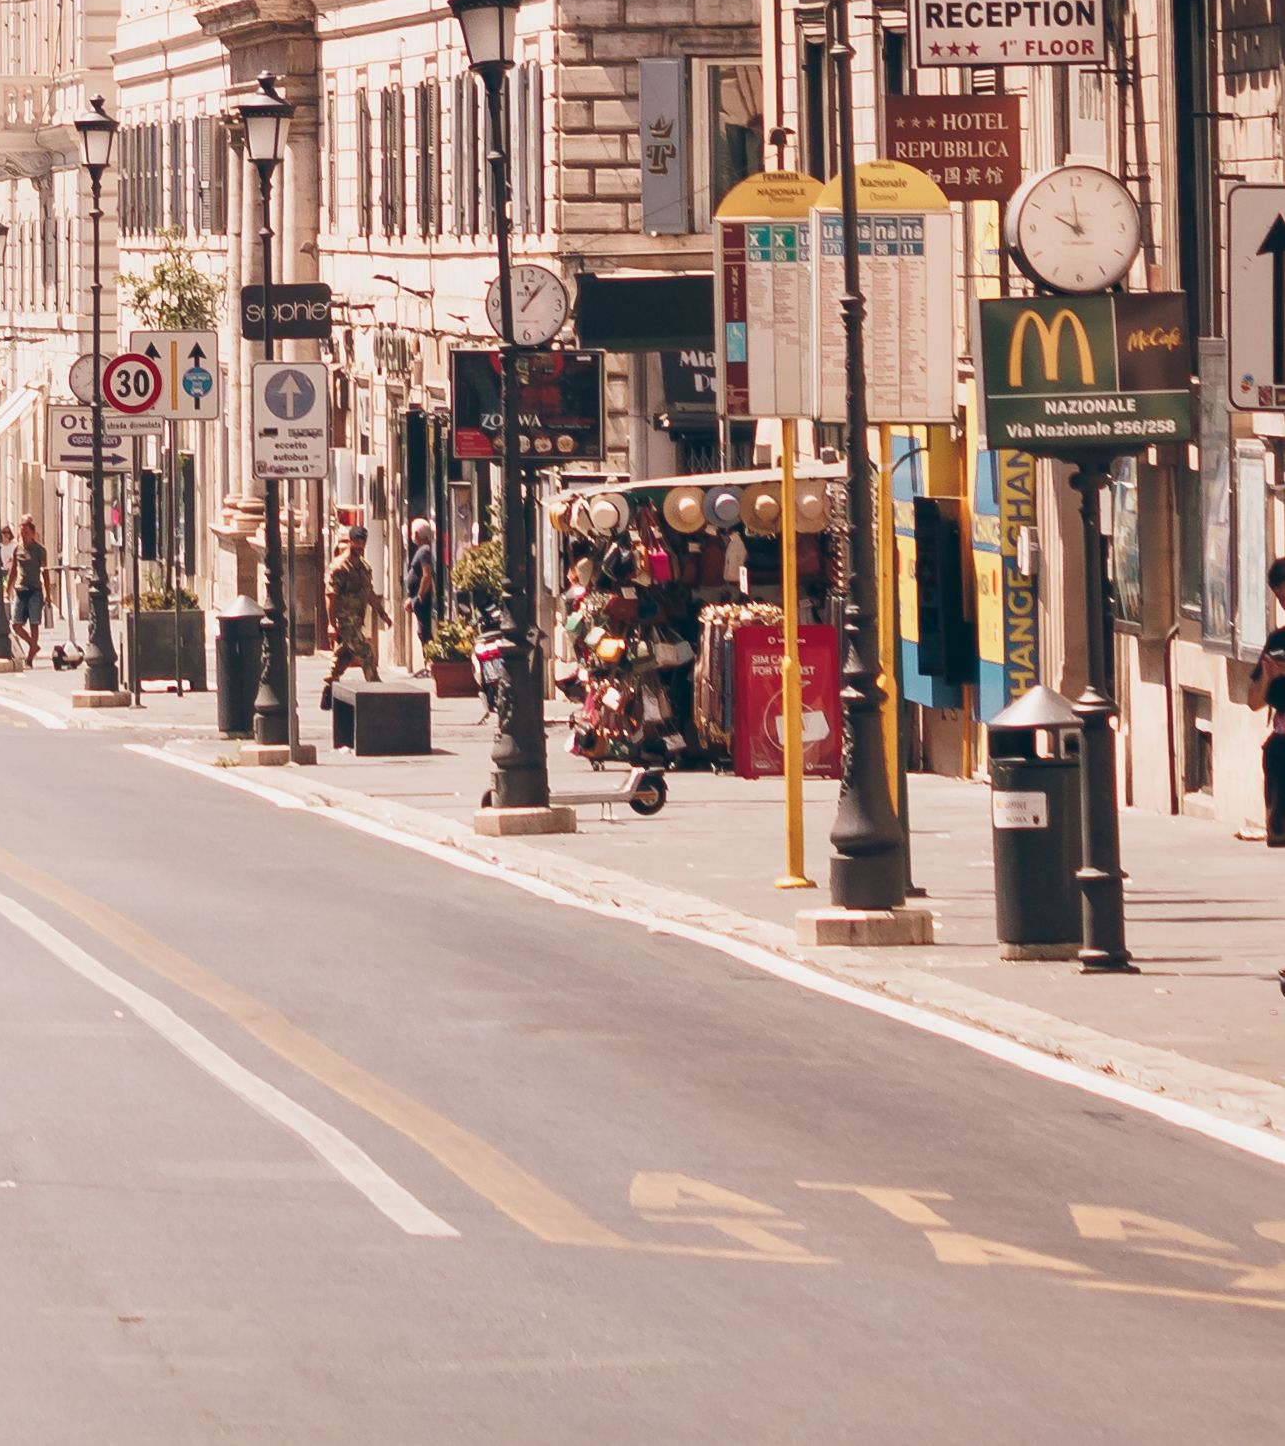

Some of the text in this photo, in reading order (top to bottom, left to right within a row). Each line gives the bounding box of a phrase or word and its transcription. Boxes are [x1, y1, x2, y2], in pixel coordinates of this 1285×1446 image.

[925, 0, 1096, 29] RECEPTION
[1025, 39, 1095, 55] FLOOR
[942, 113, 1009, 130] HOTEL
[895, 140, 1009, 159] REPUBBLICA
[860, 177, 908, 188] Nazionale
[756, 188, 806, 197] NAZIONALE
[519, 269, 535, 283] 12
[554, 299, 563, 312] 3
[522, 328, 532, 341] 6
[116, 369, 150, 398] 30
[1044, 398, 1137, 415] NAZIONALE
[1005, 420, 1177, 438] Via Nazionale 256/258
[274, 441, 308, 450] eccetto
[1007, 449, 1035, 550] CHAN
[1007, 566, 1036, 704] HANGE
[751, 655, 769, 664] SIM
[752, 666, 772, 675] FOR
